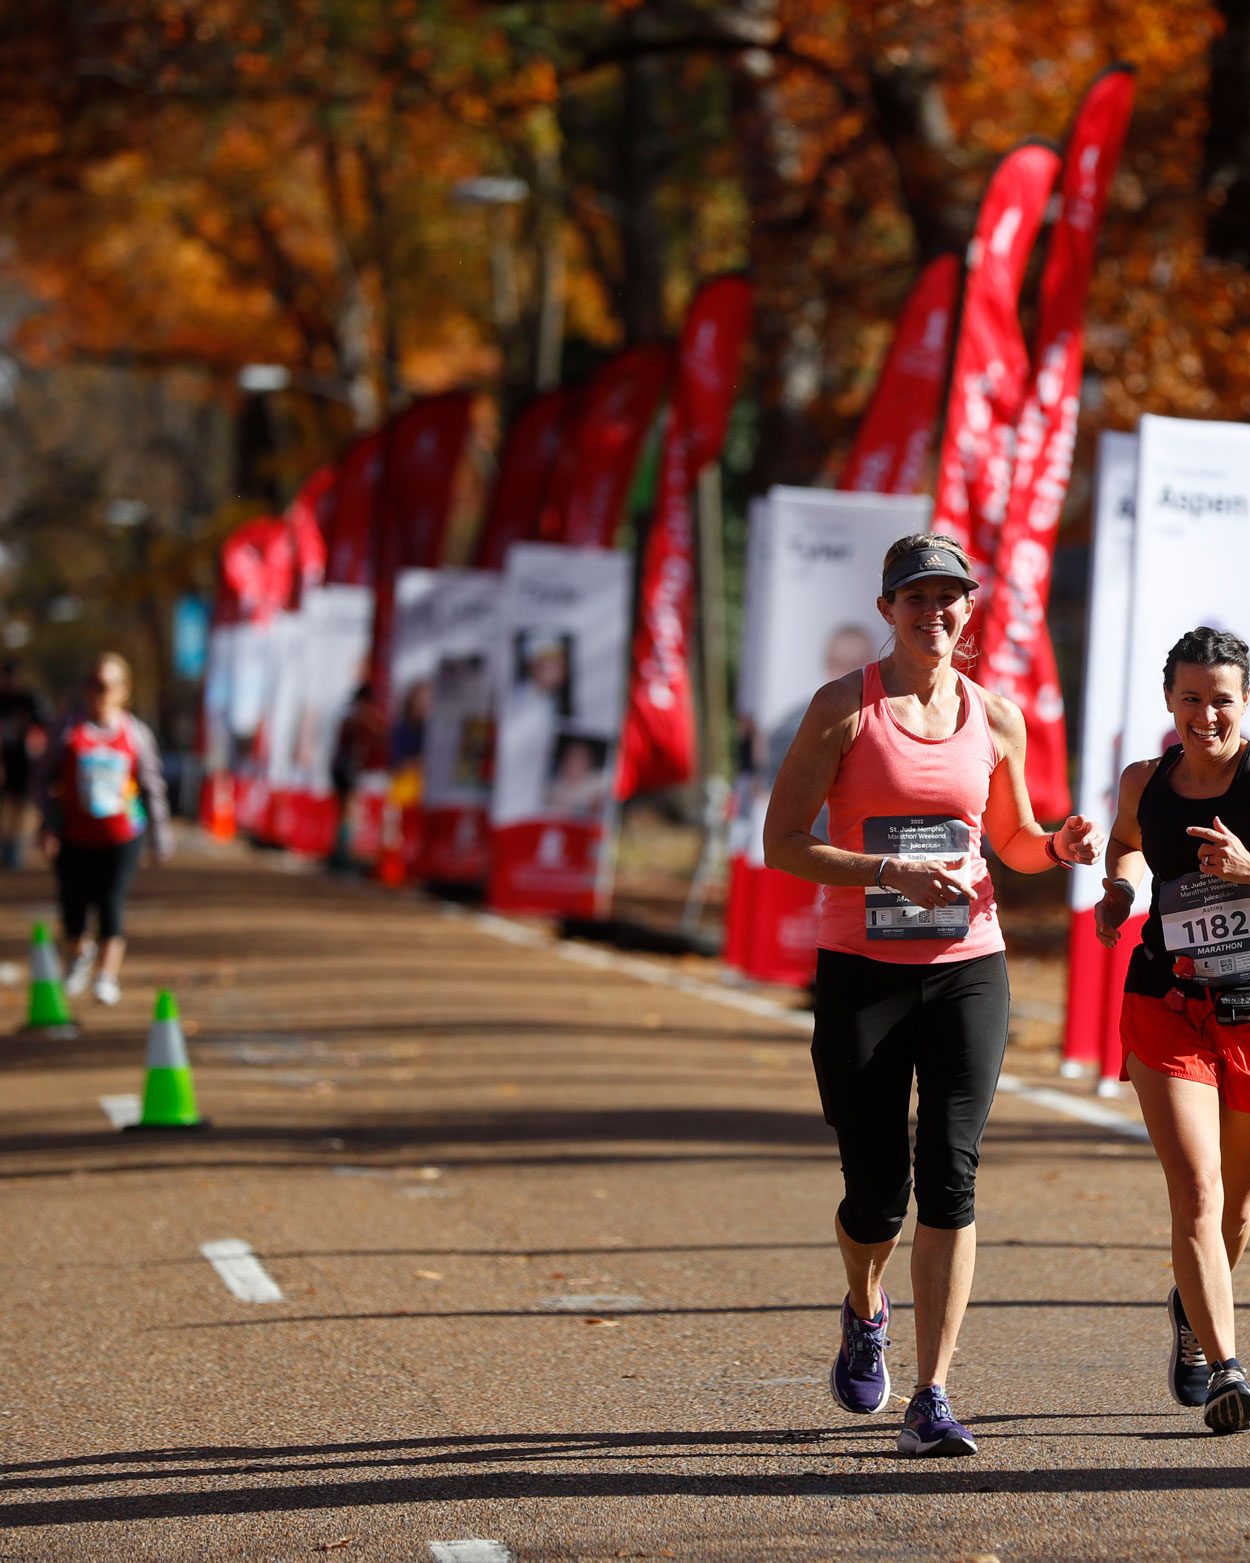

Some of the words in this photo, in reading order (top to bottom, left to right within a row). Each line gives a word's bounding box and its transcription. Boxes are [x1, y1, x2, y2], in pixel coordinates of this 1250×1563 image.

[1191, 880, 1206, 889] Jude
[1180, 886, 1210, 898] Marathon
[1202, 904, 1224, 914] Ashley
[1182, 910, 1250, 944] 1182
[1198, 941, 1243, 955] MARATHON
